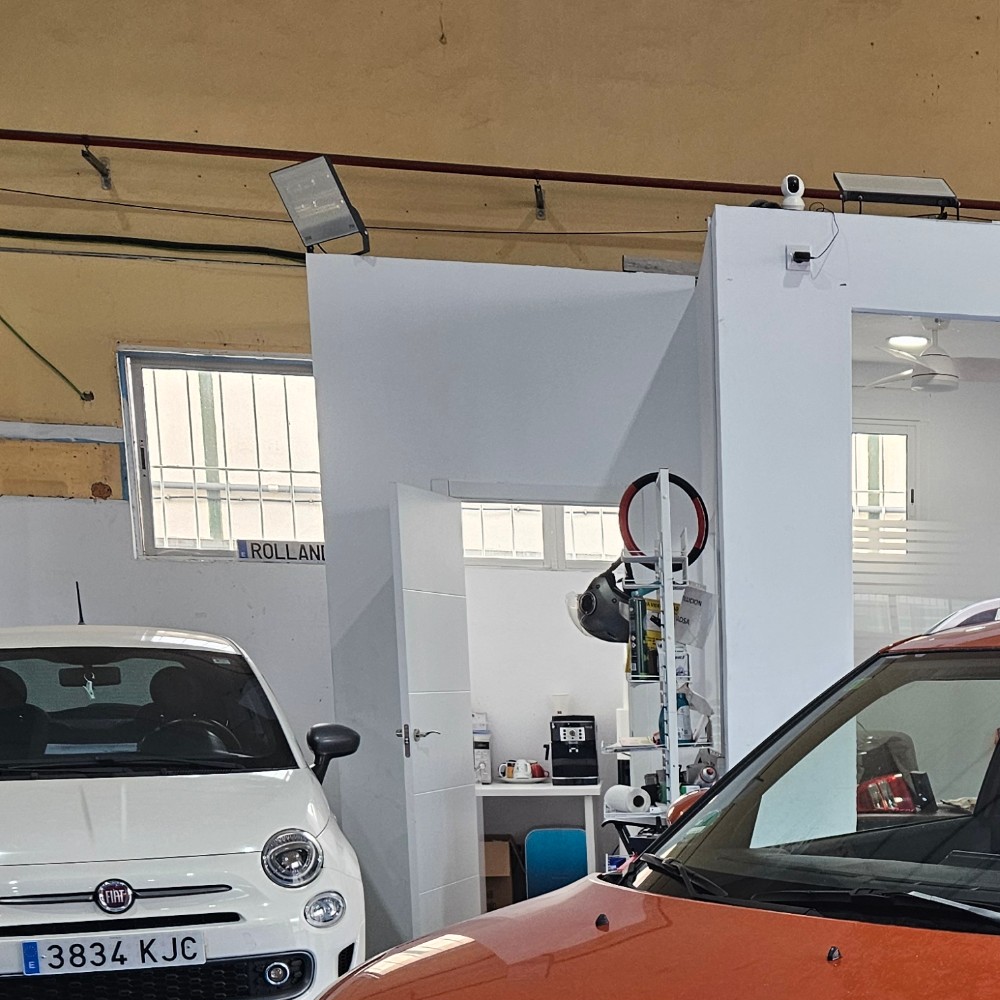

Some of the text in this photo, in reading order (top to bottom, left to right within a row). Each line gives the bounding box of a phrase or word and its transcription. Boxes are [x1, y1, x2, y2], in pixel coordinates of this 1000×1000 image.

[105, 889, 126, 904] FIAT
[47, 940, 128, 970] 3834
[139, 936, 198, 964] KJC
